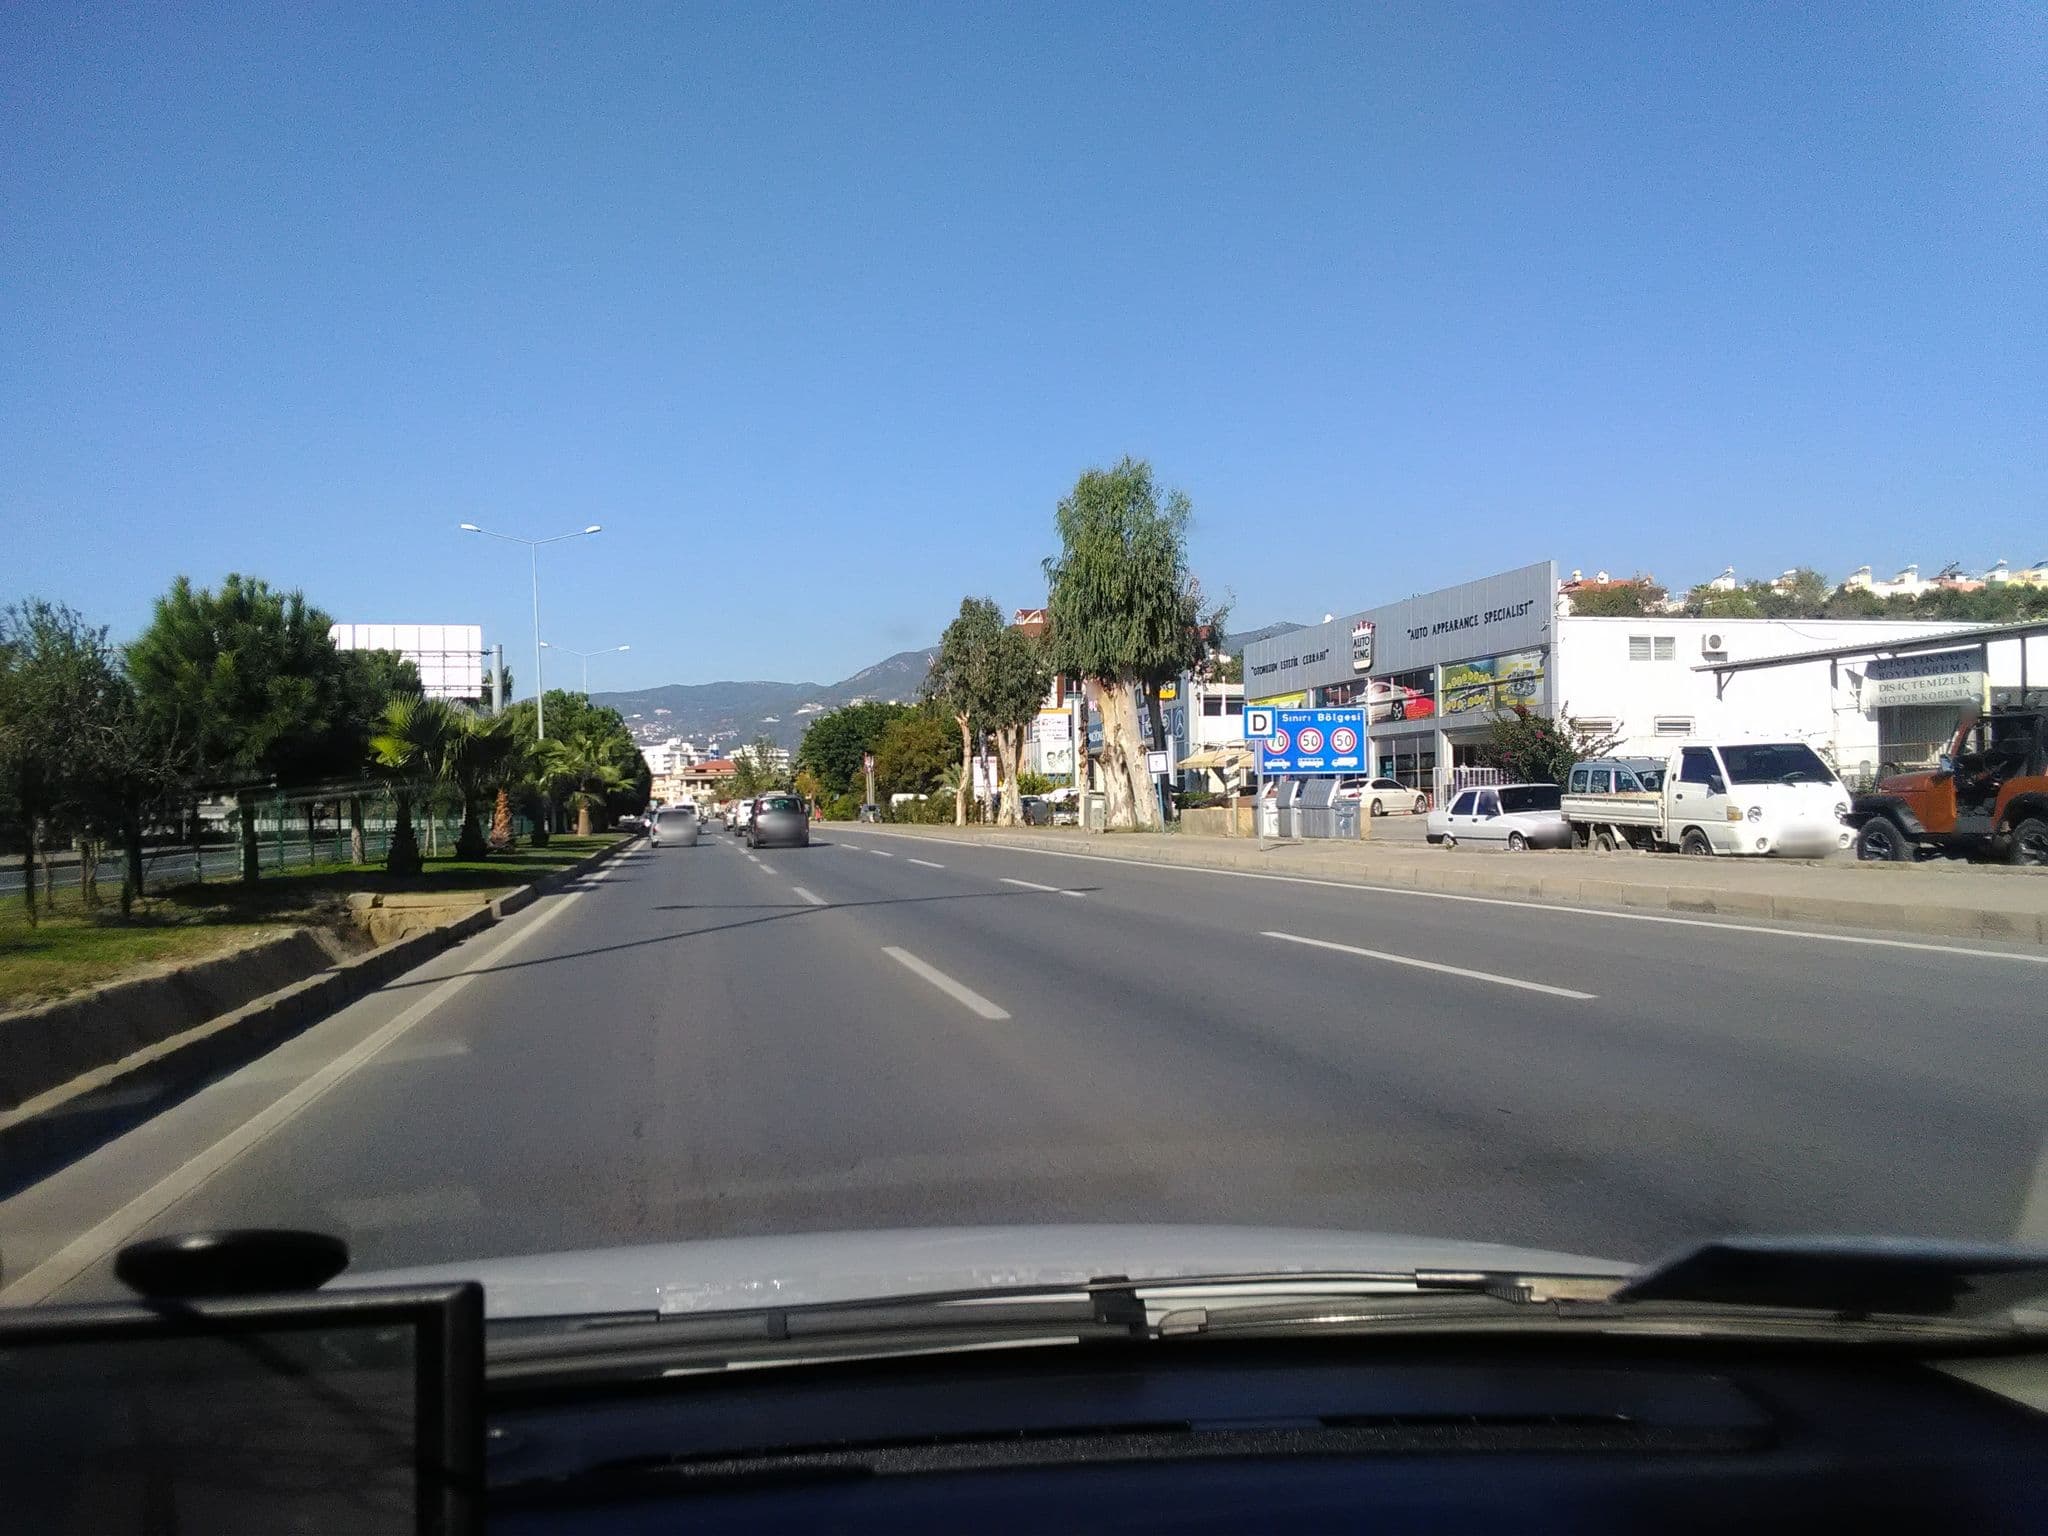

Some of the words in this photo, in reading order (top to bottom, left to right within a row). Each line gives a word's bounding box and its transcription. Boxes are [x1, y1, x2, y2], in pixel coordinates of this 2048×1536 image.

[1432, 614, 1479, 635] APPEARANCE
[1353, 636, 1370, 648] AUTO
[1913, 662, 1970, 676] KORUMA
[1879, 693, 1918, 705] MOTOR
[1921, 688, 1972, 701] KORUMA
[1253, 714, 1267, 731] D
[1318, 713, 1360, 723] Bölgesi
[1303, 735, 1318, 747] 50
[1336, 735, 1352, 747] 50
